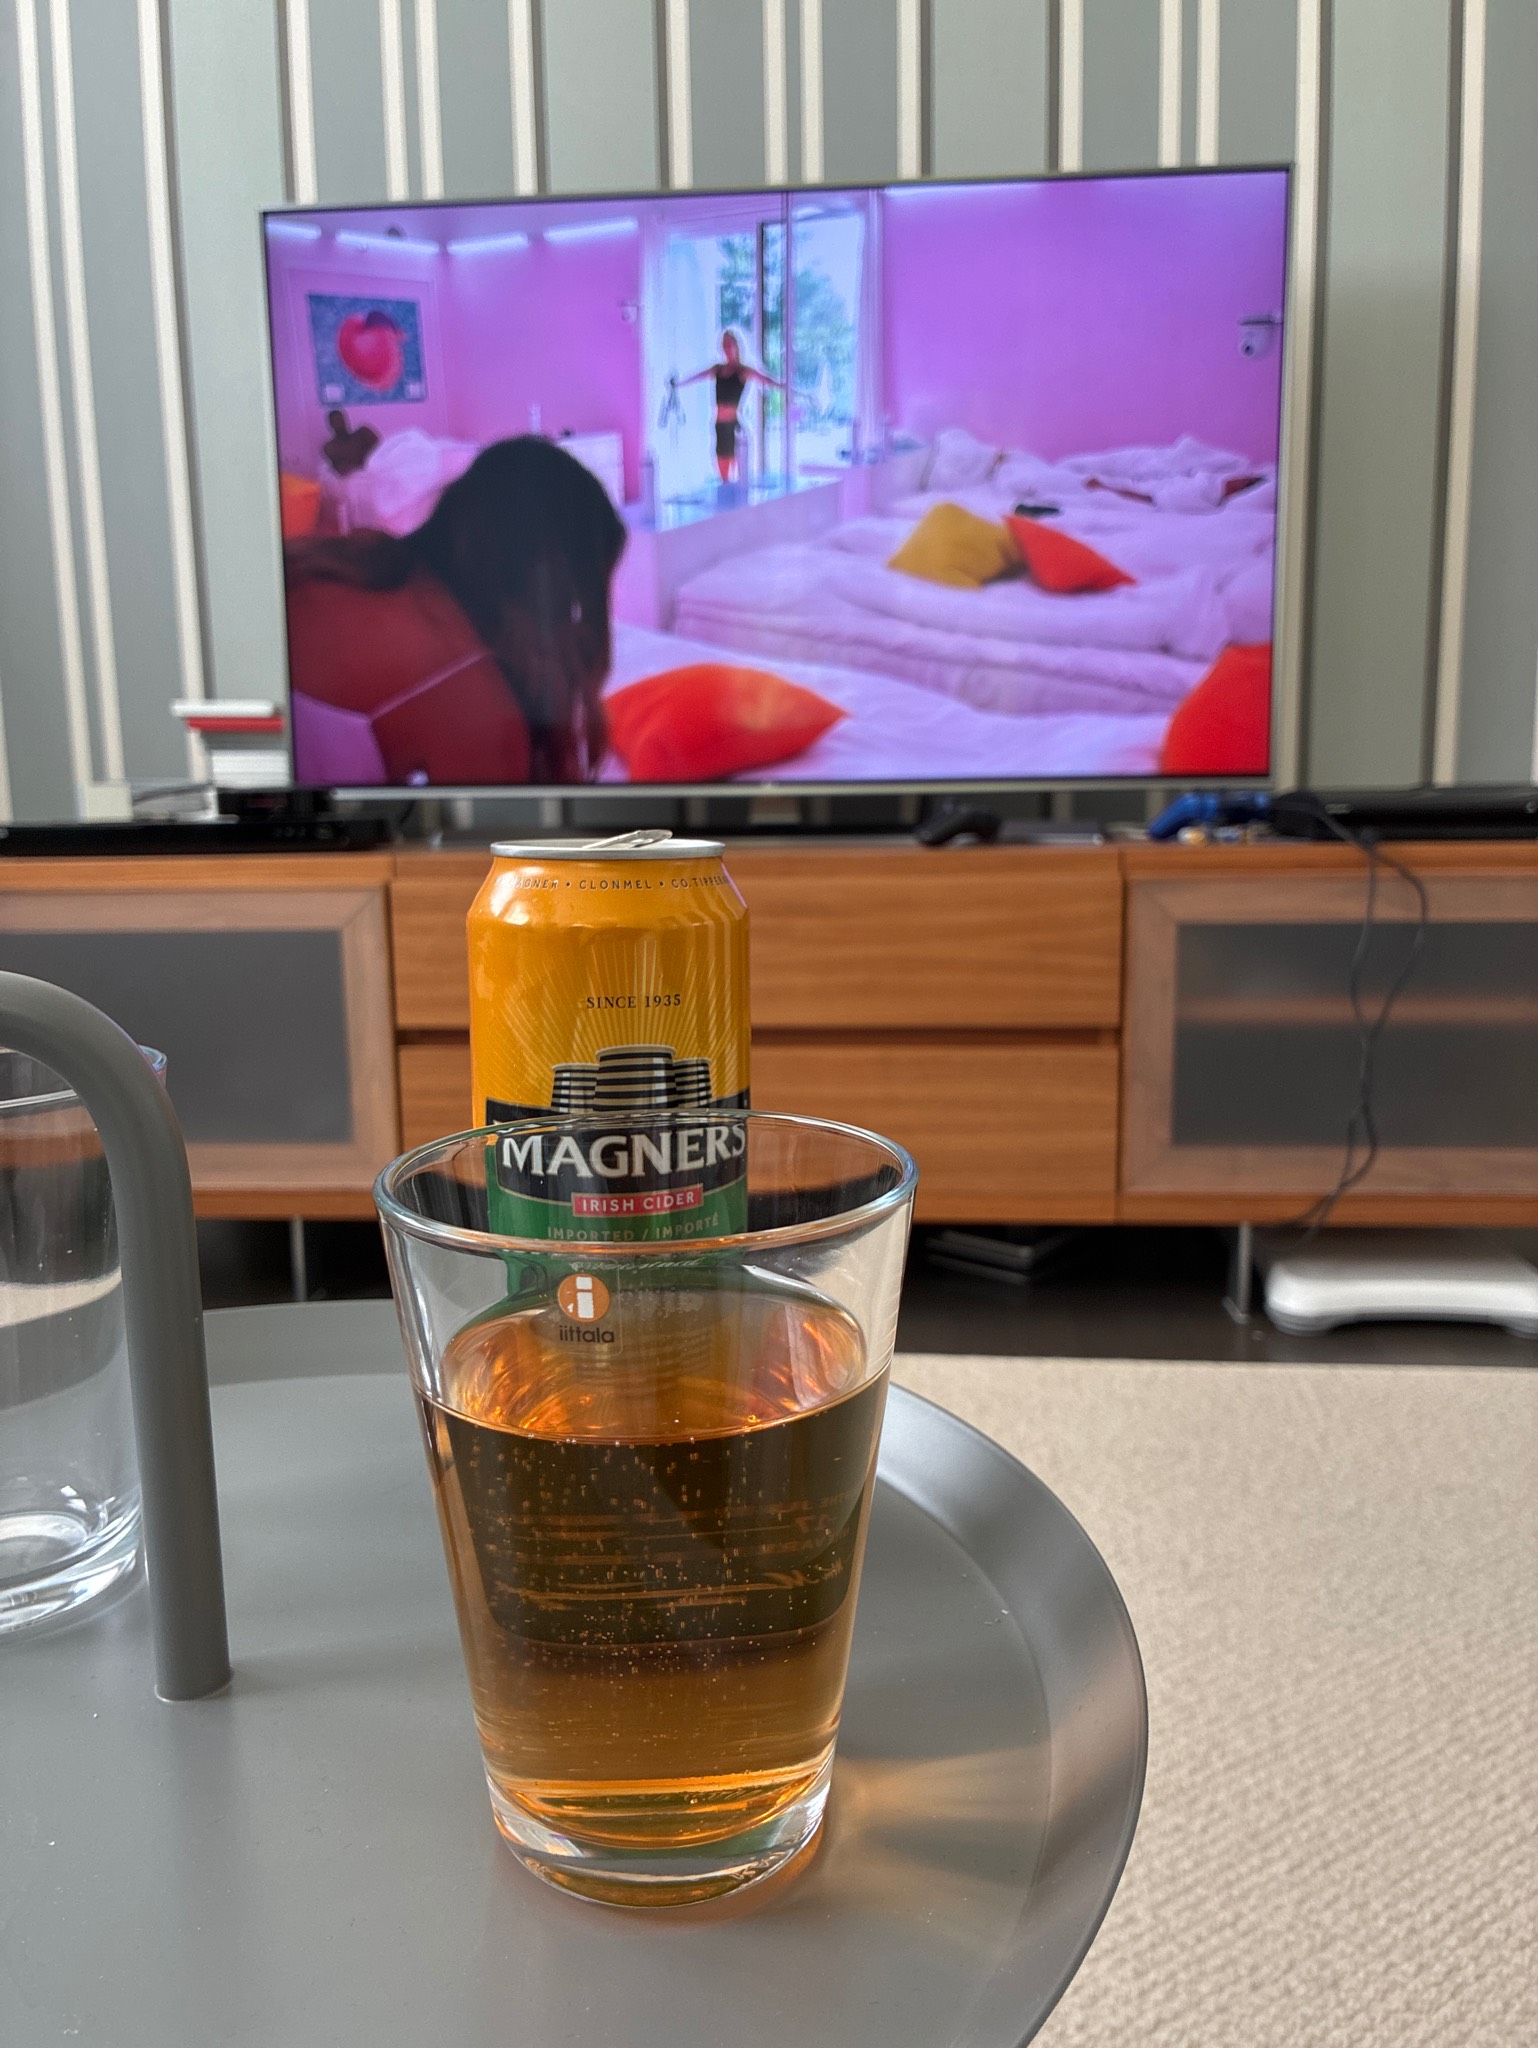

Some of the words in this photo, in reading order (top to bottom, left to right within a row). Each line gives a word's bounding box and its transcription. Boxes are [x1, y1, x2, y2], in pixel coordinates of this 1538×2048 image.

[579, 879, 652, 890] CLONMEL
[586, 996, 637, 1009] SINCE
[644, 994, 681, 1008] 1935
[502, 1122, 746, 1178] MAGNERS
[582, 1196, 634, 1212] IRISH
[643, 1191, 695, 1210] CIDER
[547, 1226, 634, 1242] IMPORTED
[655, 1211, 719, 1239] IMPORTÉ
[558, 1325, 615, 1344] iittala
